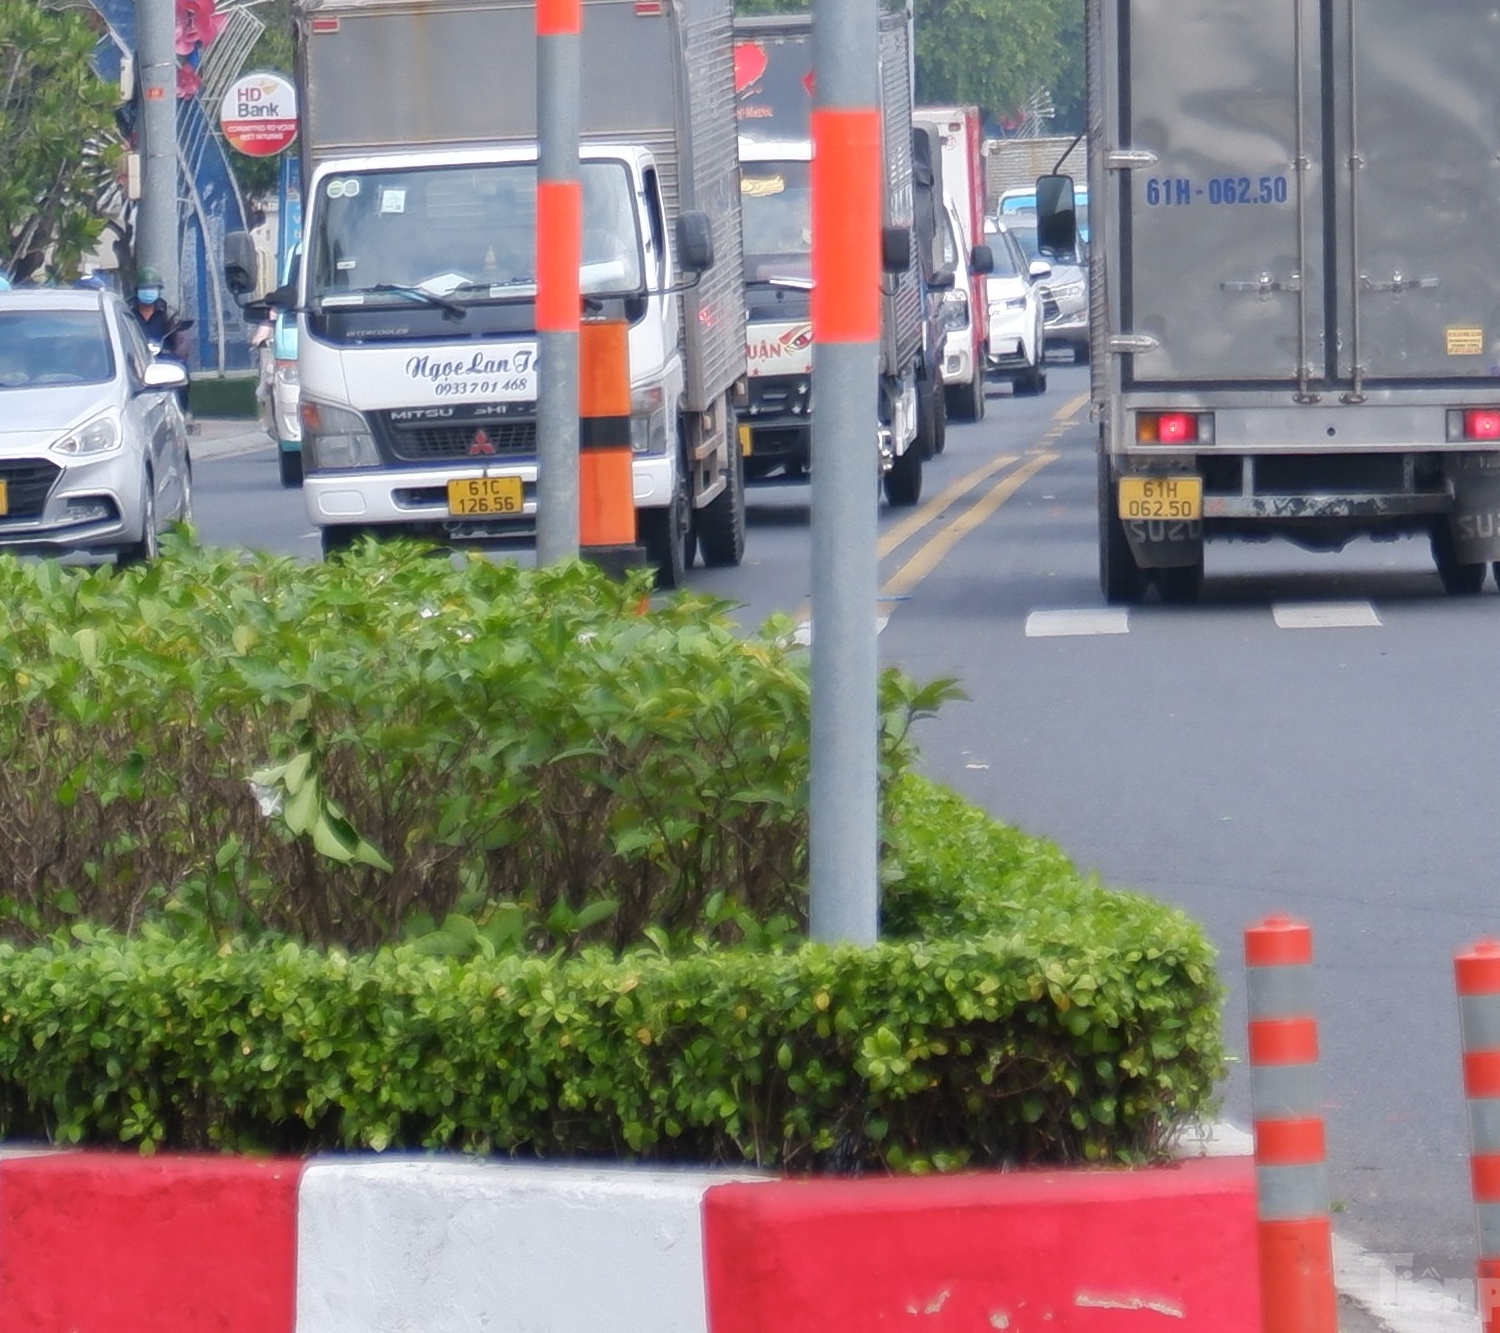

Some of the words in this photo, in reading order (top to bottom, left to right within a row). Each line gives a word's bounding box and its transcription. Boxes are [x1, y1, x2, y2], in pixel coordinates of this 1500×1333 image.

[238, 87, 262, 102] HD
[238, 102, 279, 118] Bank
[1147, 178, 1191, 206] 61H
[1208, 176, 1288, 205] 062.50
[745, 339, 781, 363] UẬN
[435, 382, 467, 396] 0933
[470, 380, 499, 394] 701
[501, 378, 528, 392] 468
[468, 480, 501, 496] 61C
[1142, 481, 1178, 498] 61H
[459, 496, 514, 514] 126.56
[1128, 500, 1193, 518] 062.50
